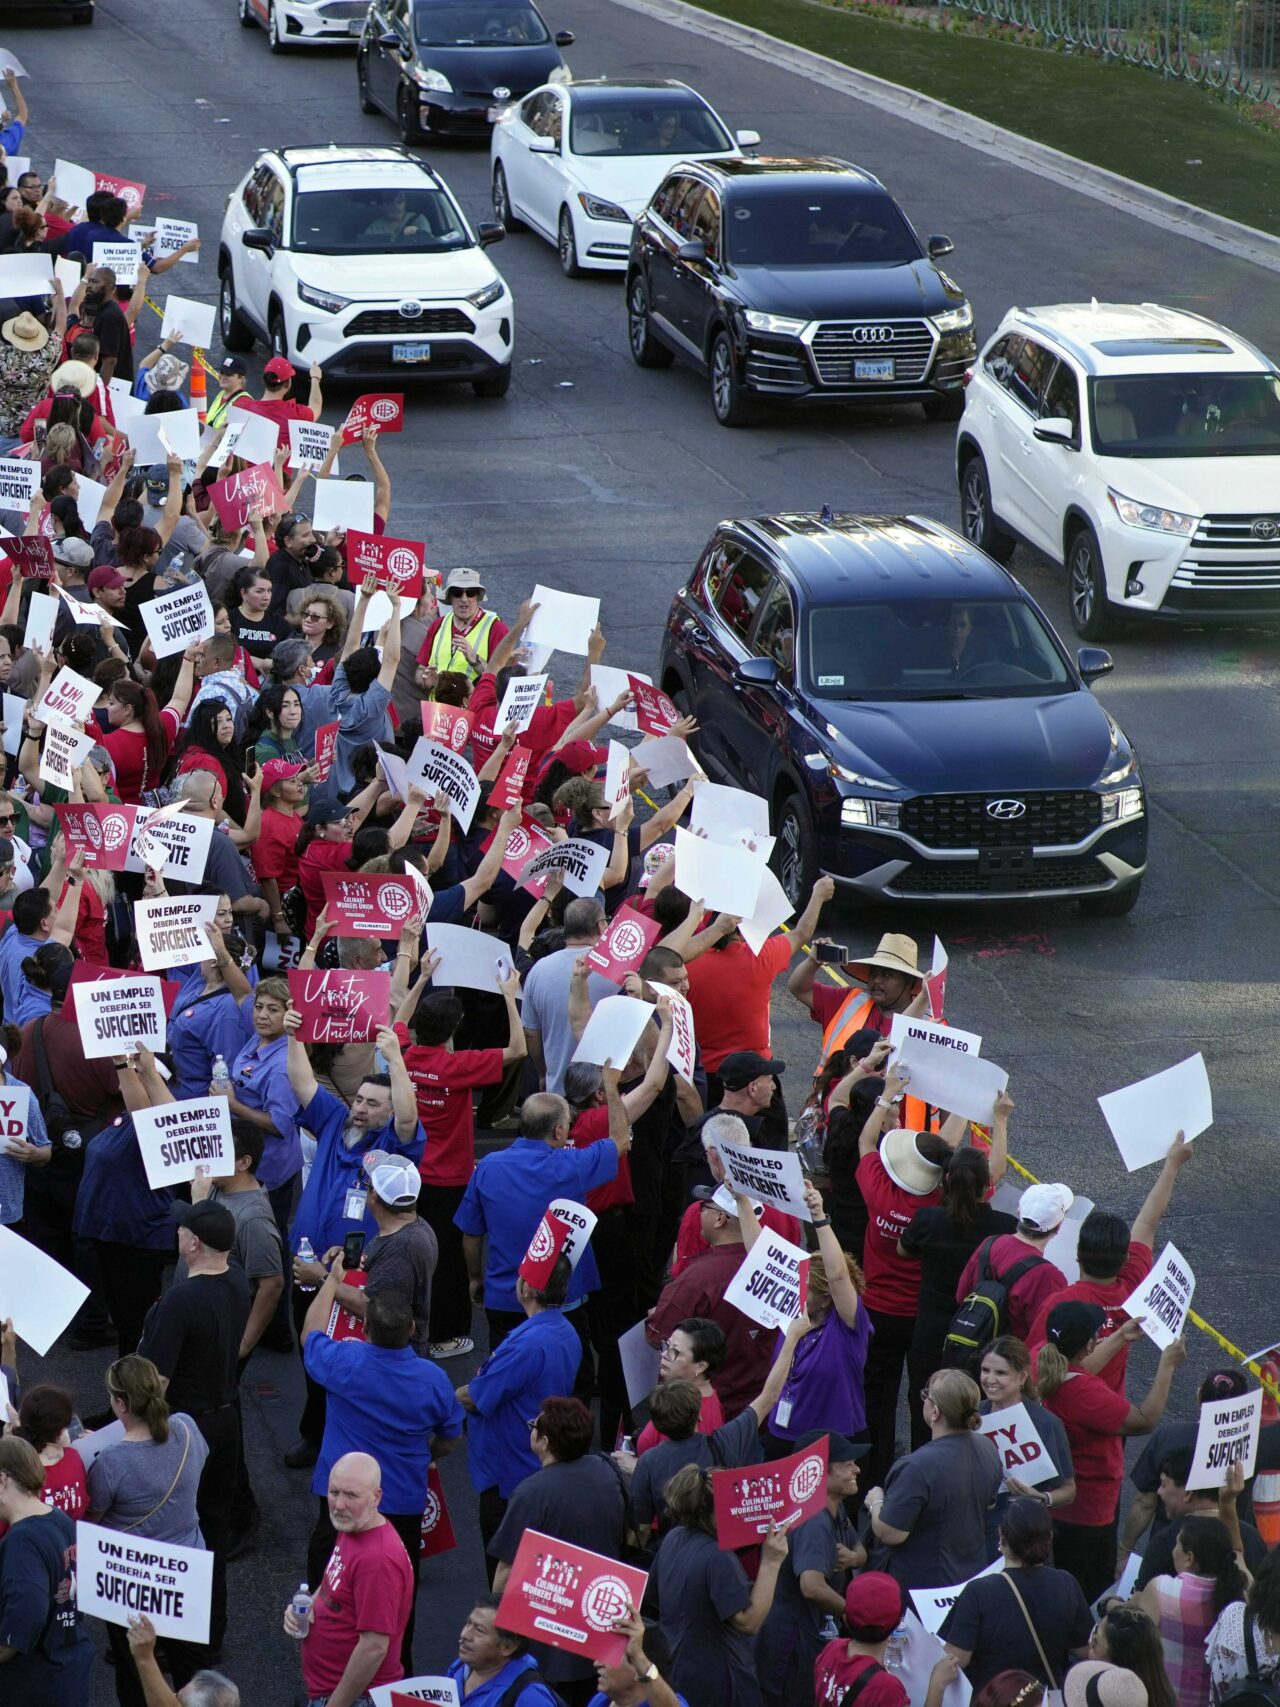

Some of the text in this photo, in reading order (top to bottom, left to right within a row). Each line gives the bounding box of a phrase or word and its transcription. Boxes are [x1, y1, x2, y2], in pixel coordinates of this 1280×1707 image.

[310, 429, 329, 438] EMPLEO
[8, 466, 32, 474] EMPLEO
[155, 591, 203, 614] UN EMPLEO
[161, 610, 206, 641] SUFICIENTE
[239, 628, 272, 641] PINK
[472, 731, 493, 746] UNITE
[431, 749, 474, 790] UN EMPLEO
[421, 763, 469, 811] SUFICIENTE
[552, 843, 594, 856] EMPLEO
[572, 850, 585, 860] SER
[529, 856, 588, 881] SUFICIENTE
[148, 905, 201, 918] UN EMPLEO
[359, 902, 374, 910] UNION
[181, 917, 192, 925] SER
[150, 927, 202, 953] SUFICIENTE
[91, 988, 154, 1003] UN EMPLEO
[95, 1013, 158, 1039] SUFICIENTE
[314, 1014, 372, 1042] Unidad
[908, 1028, 968, 1052] UN EMPLEO
[414, 1068, 428, 1079] Union
[155, 1108, 220, 1128] UN EMPLEO
[161, 1135, 223, 1166] SUFICIENTE
[738, 1153, 783, 1170] EMPLEO
[728, 1164, 791, 1202] SUFICIENTE
[876, 1216, 907, 1234] UNIT
[890, 1211, 911, 1223] Culinary
[767, 1245, 785, 1265] UN
[1167, 1260, 1178, 1278] UN
[1144, 1283, 1182, 1334] SUFICIENTE
[1214, 1405, 1254, 1425] UN EMPLEO
[1206, 1434, 1250, 1469] SUFICIENTE
[731, 1505, 762, 1515] WORKERS
[763, 1500, 784, 1510] UNION
[741, 1495, 773, 1507] CULINARY
[99, 1540, 188, 1573] UN EMPLEO
[156, 1574, 176, 1586] SER
[535, 1578, 566, 1594] CULINARY
[97, 1572, 184, 1617] SUFICIENTE
[522, 1582, 574, 1608] WORKERS UNION
[536, 1620, 586, 1640] @CULINARY226
